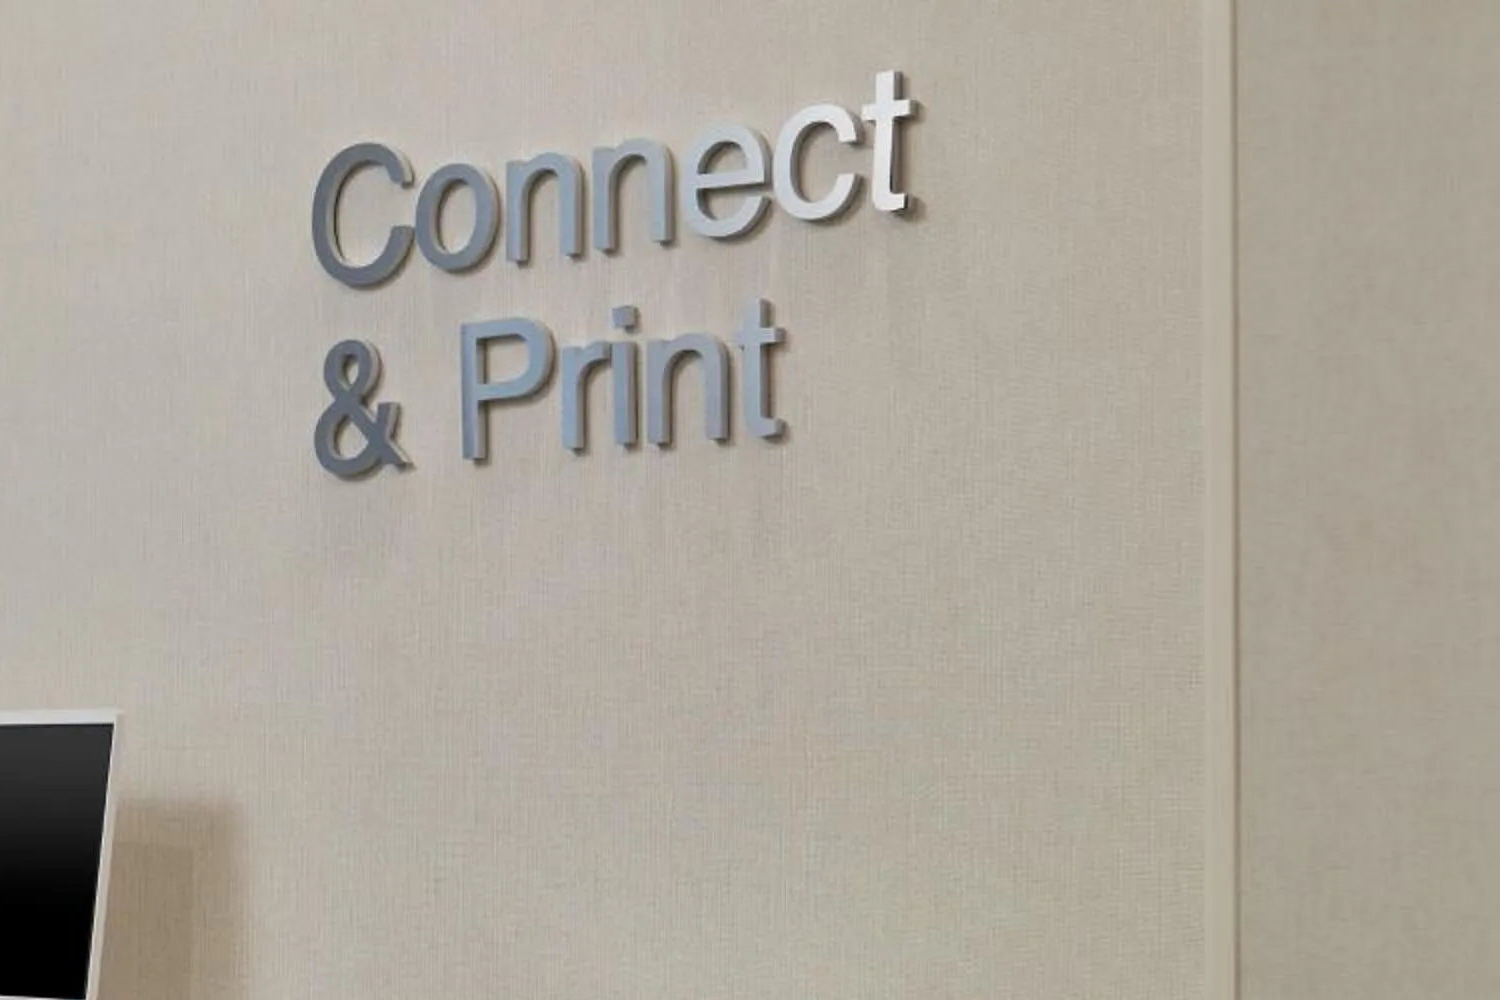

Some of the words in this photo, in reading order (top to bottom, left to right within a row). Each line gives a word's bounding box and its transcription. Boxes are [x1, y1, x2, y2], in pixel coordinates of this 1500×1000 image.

[311, 69, 921, 288] Connect
[313, 339, 411, 478] &
[460, 299, 786, 462] Print
